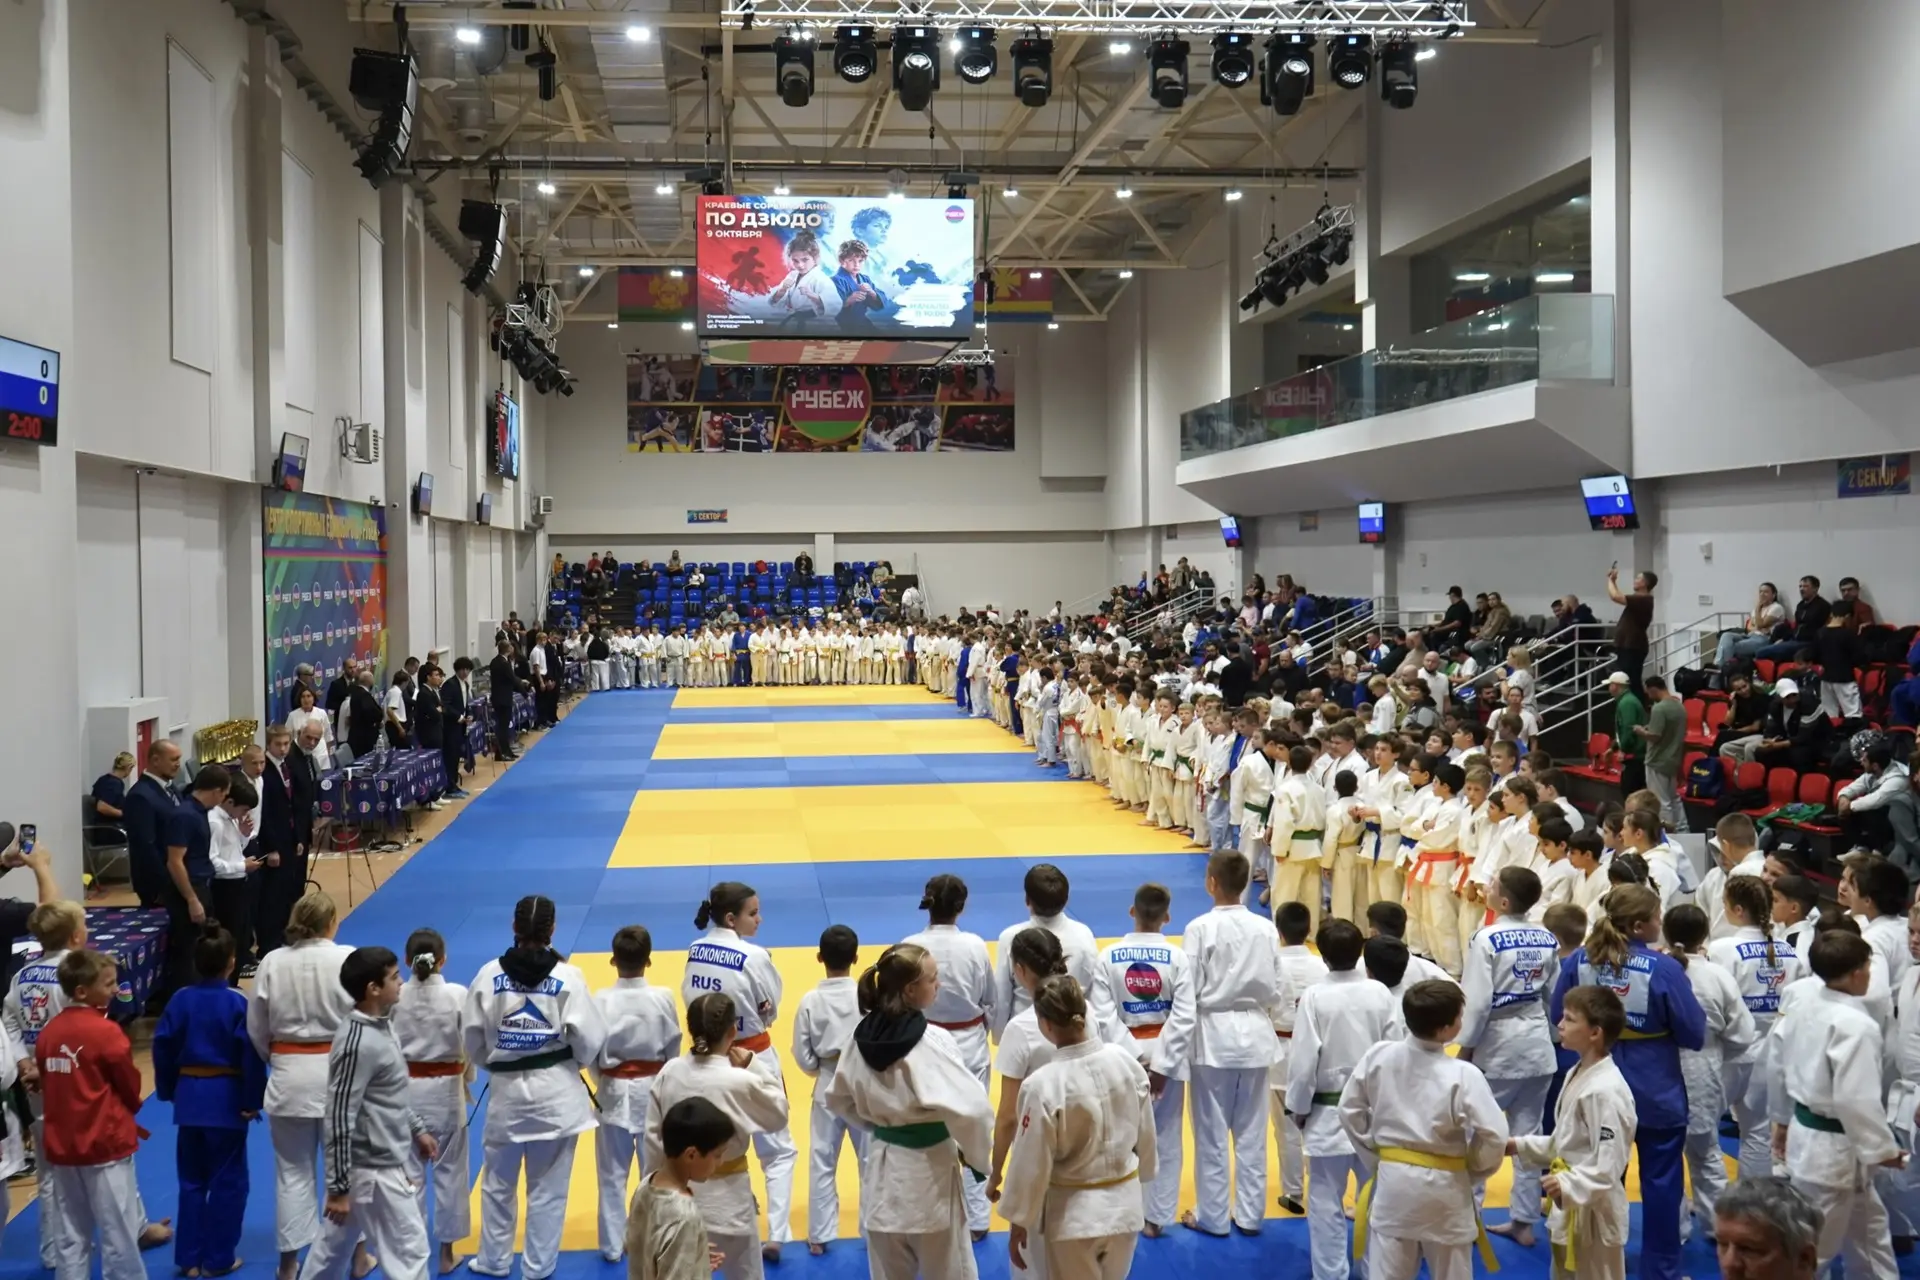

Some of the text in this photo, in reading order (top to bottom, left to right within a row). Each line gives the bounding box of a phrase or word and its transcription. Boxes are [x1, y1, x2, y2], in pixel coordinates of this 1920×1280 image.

[704, 201, 751, 209] КРАЕВЫЕ
[705, 211, 822, 229] ПО ДЗЮДО
[706, 229, 763, 238] 9 ОКТЯБРЯ
[40, 359, 49, 379] 0
[39, 385, 49, 405] 0
[791, 389, 865, 409] РУБЕЖ
[8, 412, 43, 439] 2:00
[1847, 465, 1898, 489] 2 СЕКТОР
[1613, 481, 1620, 493] 0
[1616, 495, 1625, 508] 0
[1493, 930, 1557, 949] Р.ЕРЕМЕНКО
[1113, 948, 1169, 962] ТОЛМАЧЕВ
[1516, 950, 1543, 962] ДЗЮДО
[1740, 942, 1797, 958] В.КРИЕНКО
[691, 974, 722, 992] RUS
[1126, 976, 1161, 989] РУБЕЖ
